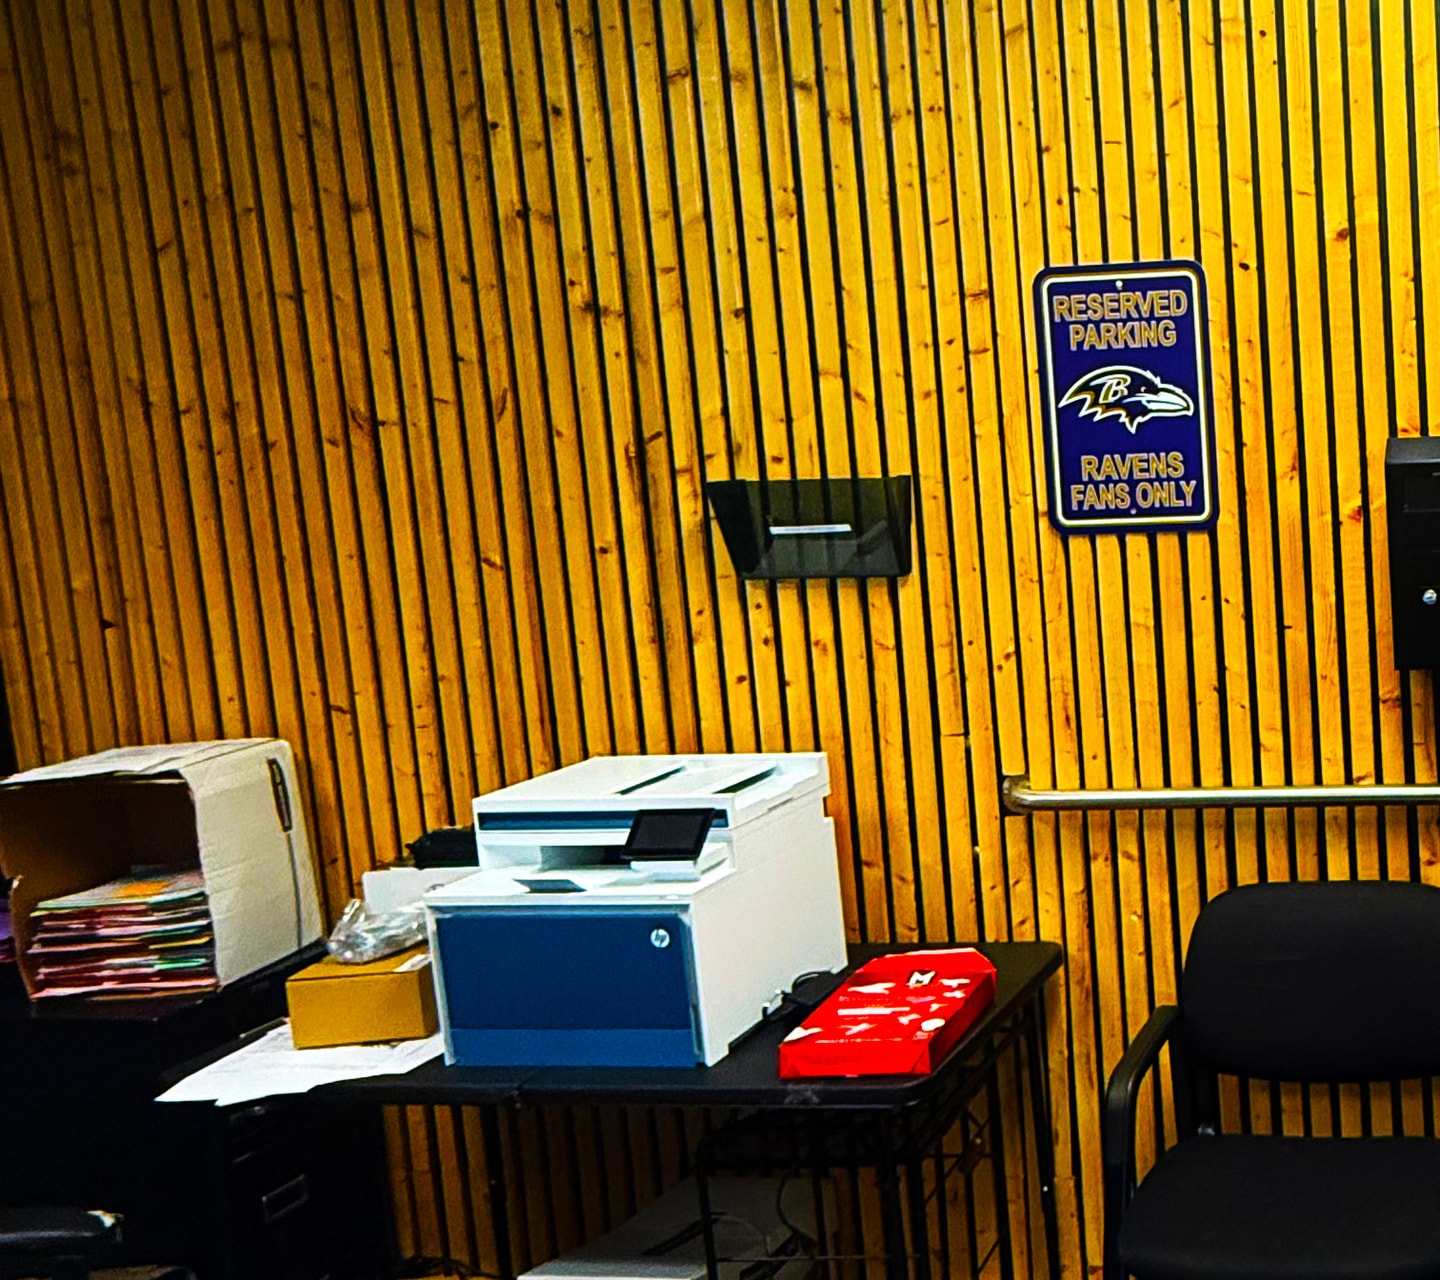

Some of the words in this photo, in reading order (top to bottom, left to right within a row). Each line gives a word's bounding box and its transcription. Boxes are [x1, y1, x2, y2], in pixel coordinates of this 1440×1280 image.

[1053, 290, 1188, 322] RESERVED
[1069, 320, 1177, 351] PARKING
[1081, 451, 1184, 481] RAVENS
[1071, 482, 1131, 510] FANS
[1136, 480, 1196, 508] ONLY
